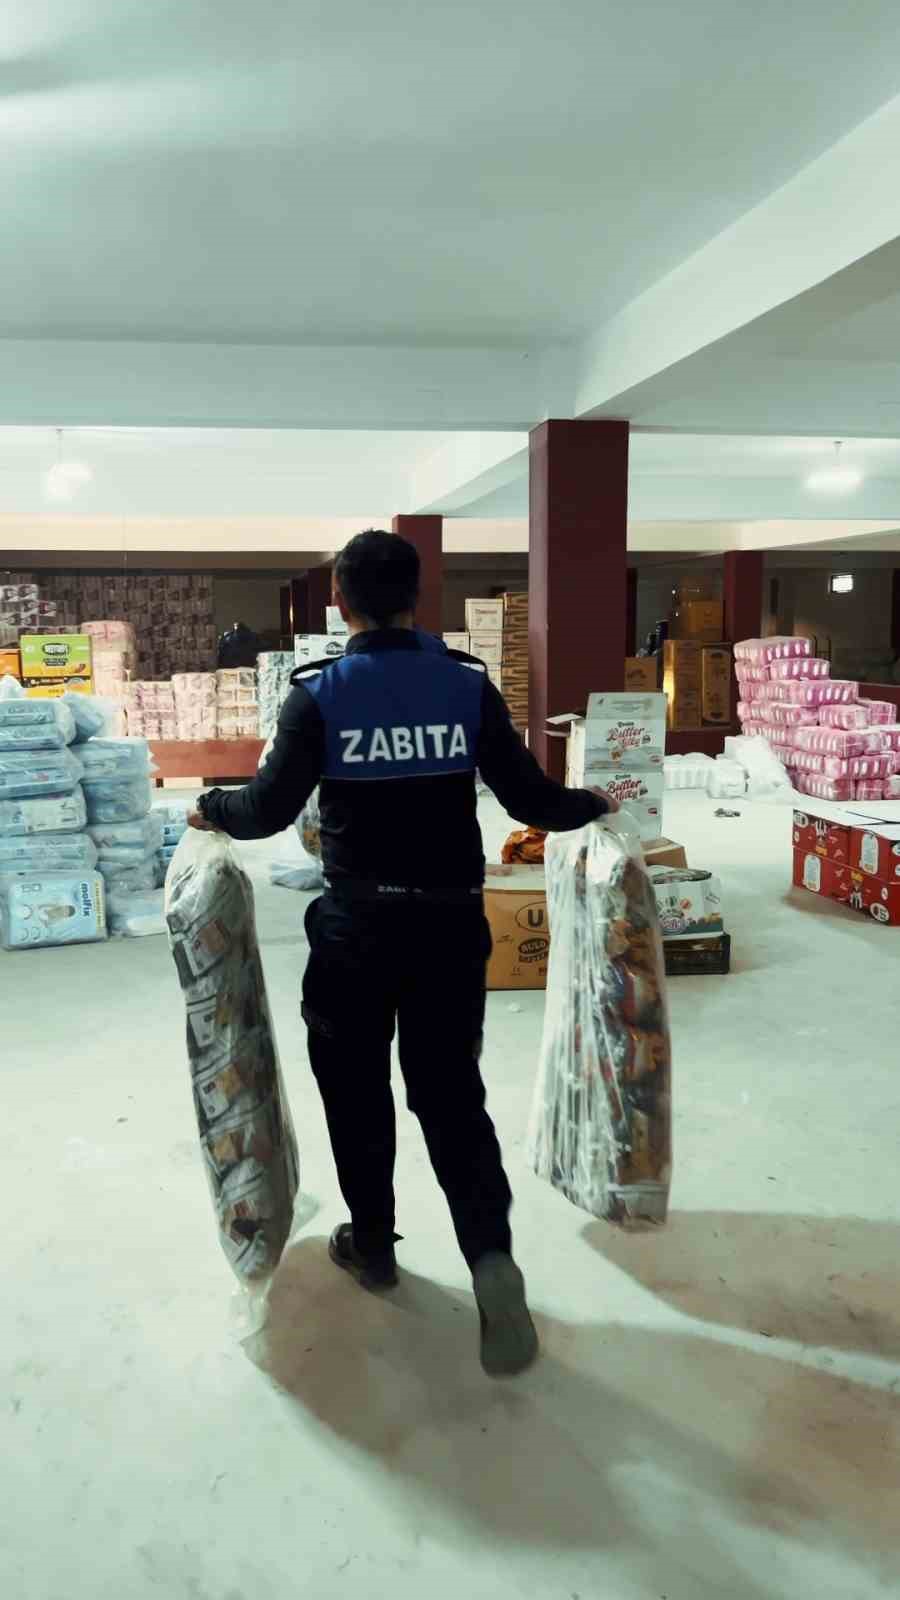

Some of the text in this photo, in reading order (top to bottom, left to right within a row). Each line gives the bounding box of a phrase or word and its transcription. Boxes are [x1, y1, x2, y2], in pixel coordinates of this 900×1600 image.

[339, 724, 468, 763] ZABITA
[606, 727, 645, 742] Butter
[606, 779, 642, 794] Butter
[80, 882, 92, 918] molfix
